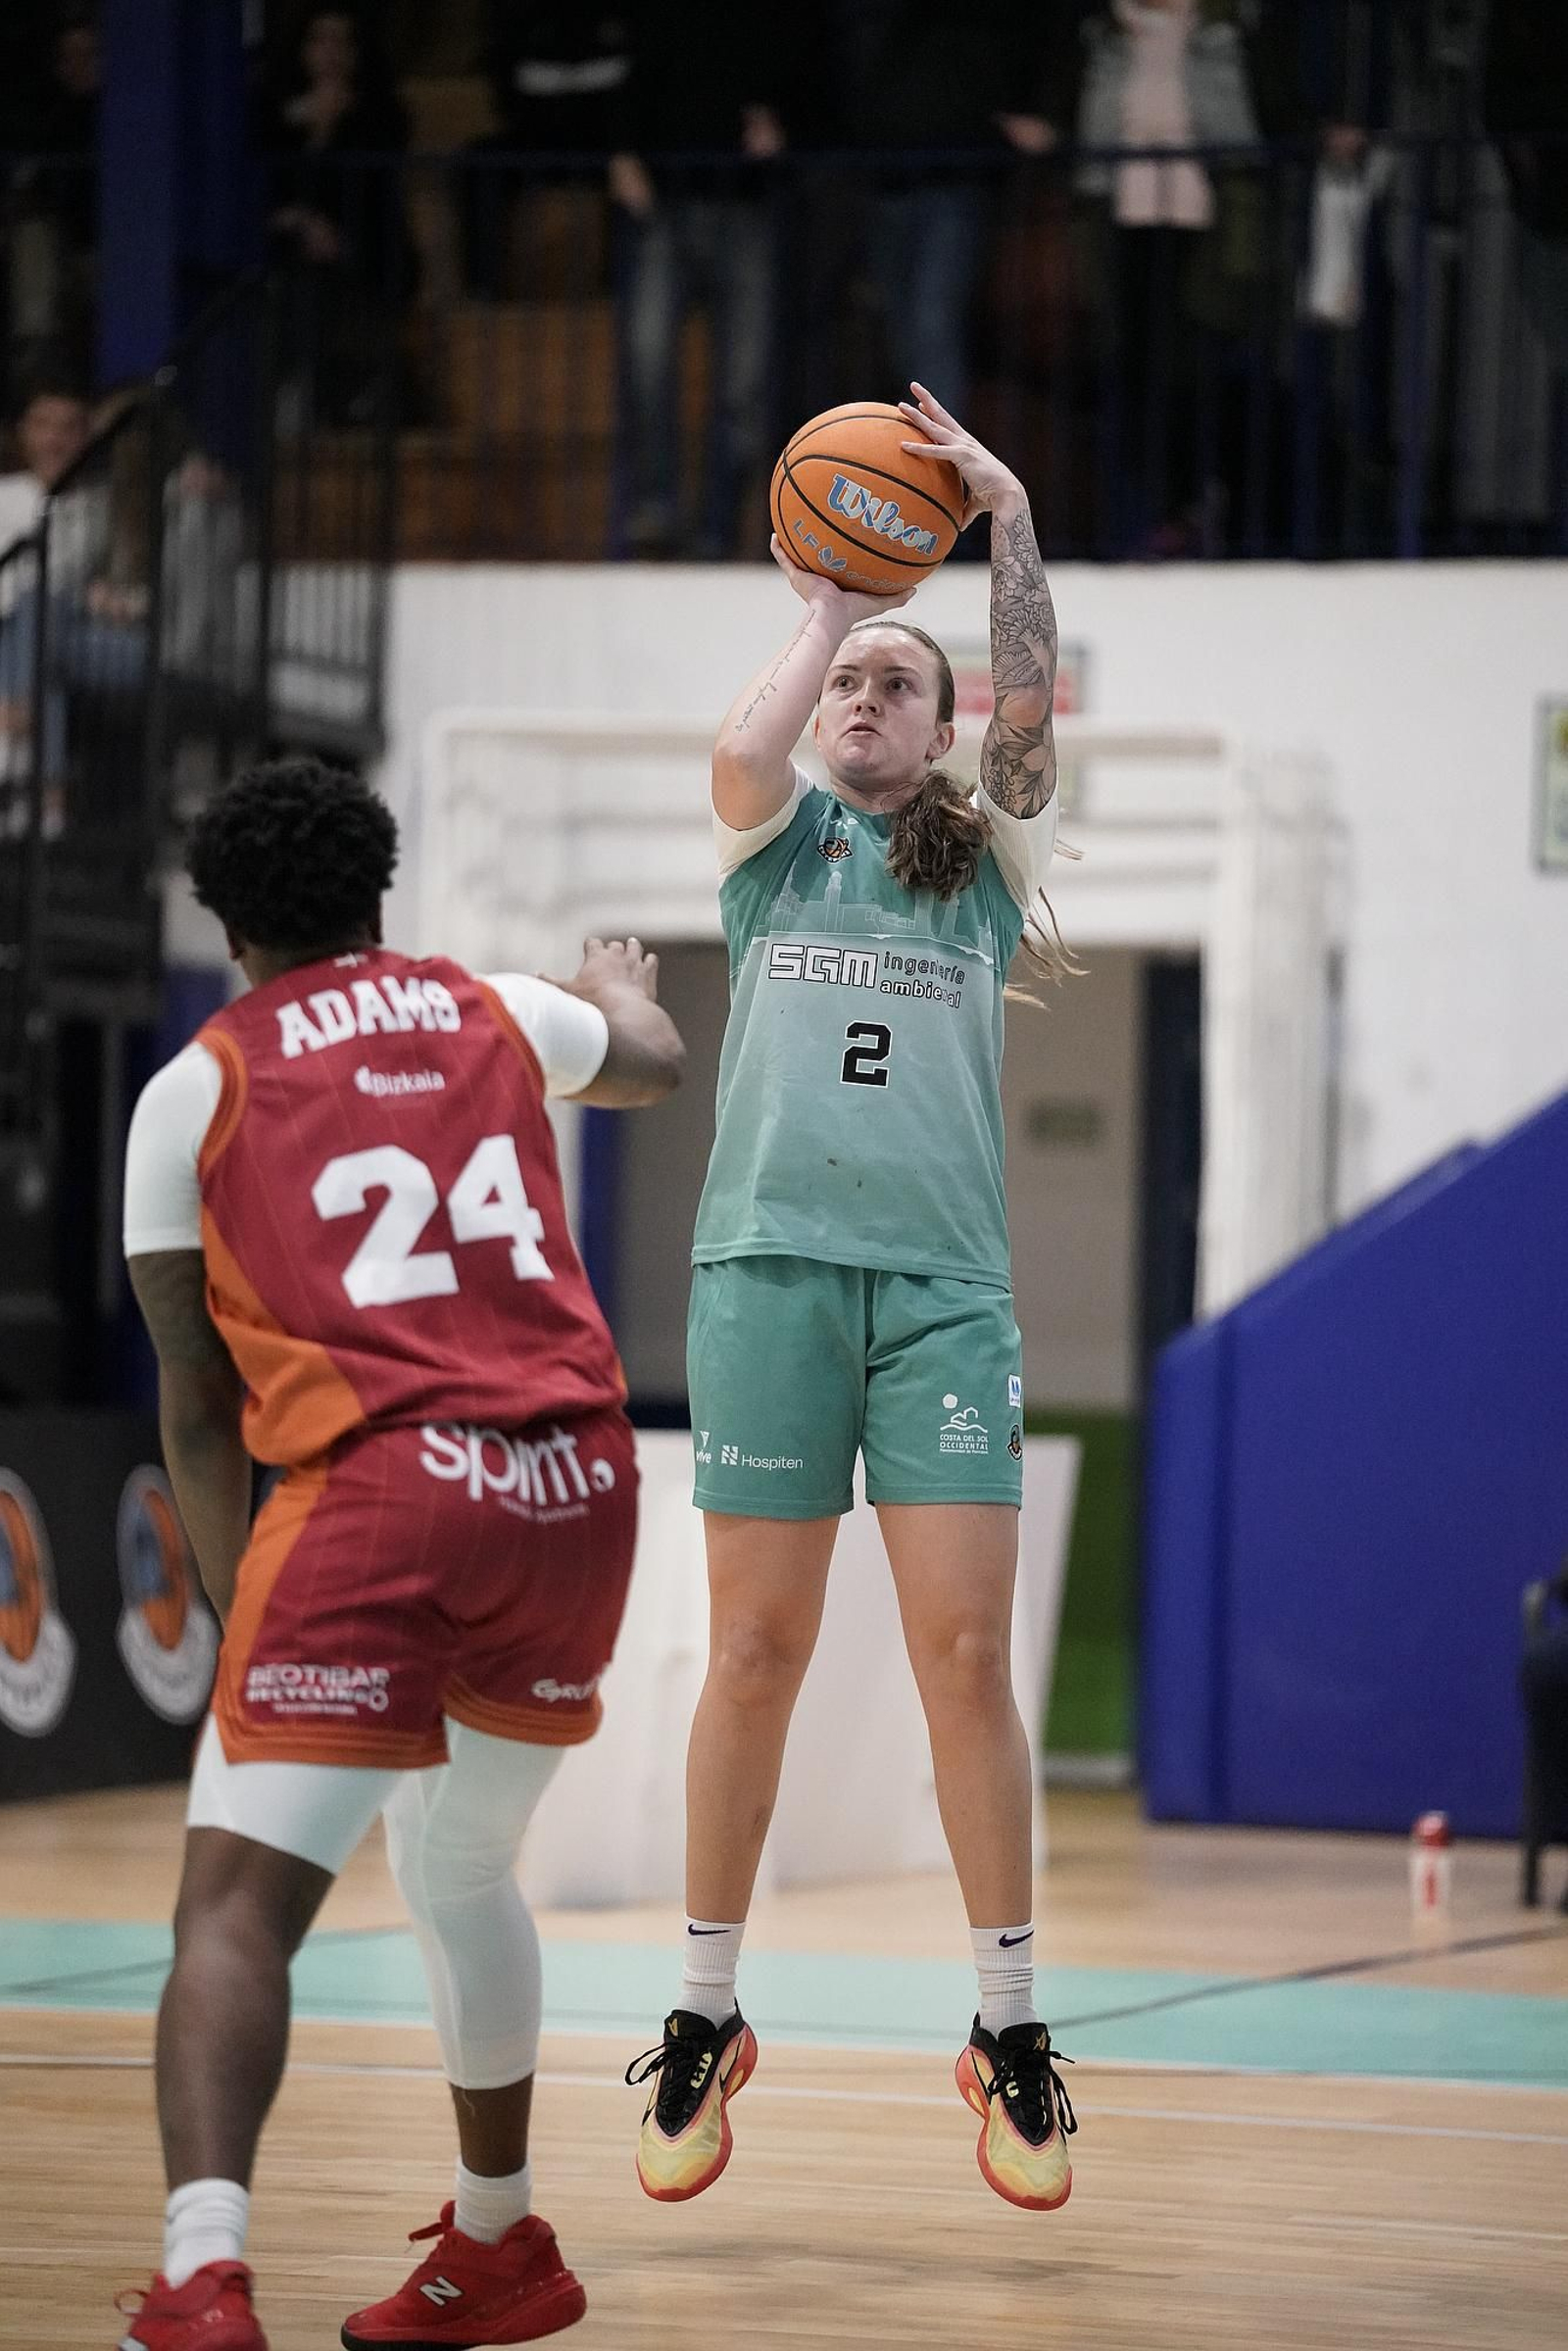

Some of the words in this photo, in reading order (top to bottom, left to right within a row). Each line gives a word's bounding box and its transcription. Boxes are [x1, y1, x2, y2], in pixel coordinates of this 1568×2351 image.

[827, 472, 939, 556] Wilson
[768, 943, 879, 989] SGM
[275, 976, 461, 1058] ADAMS
[840, 1019, 892, 1089] 2
[312, 1134, 556, 1309] 24
[742, 1454, 804, 1471] Hospiten
[940, 1442, 988, 1450] OCCIDENTAL
